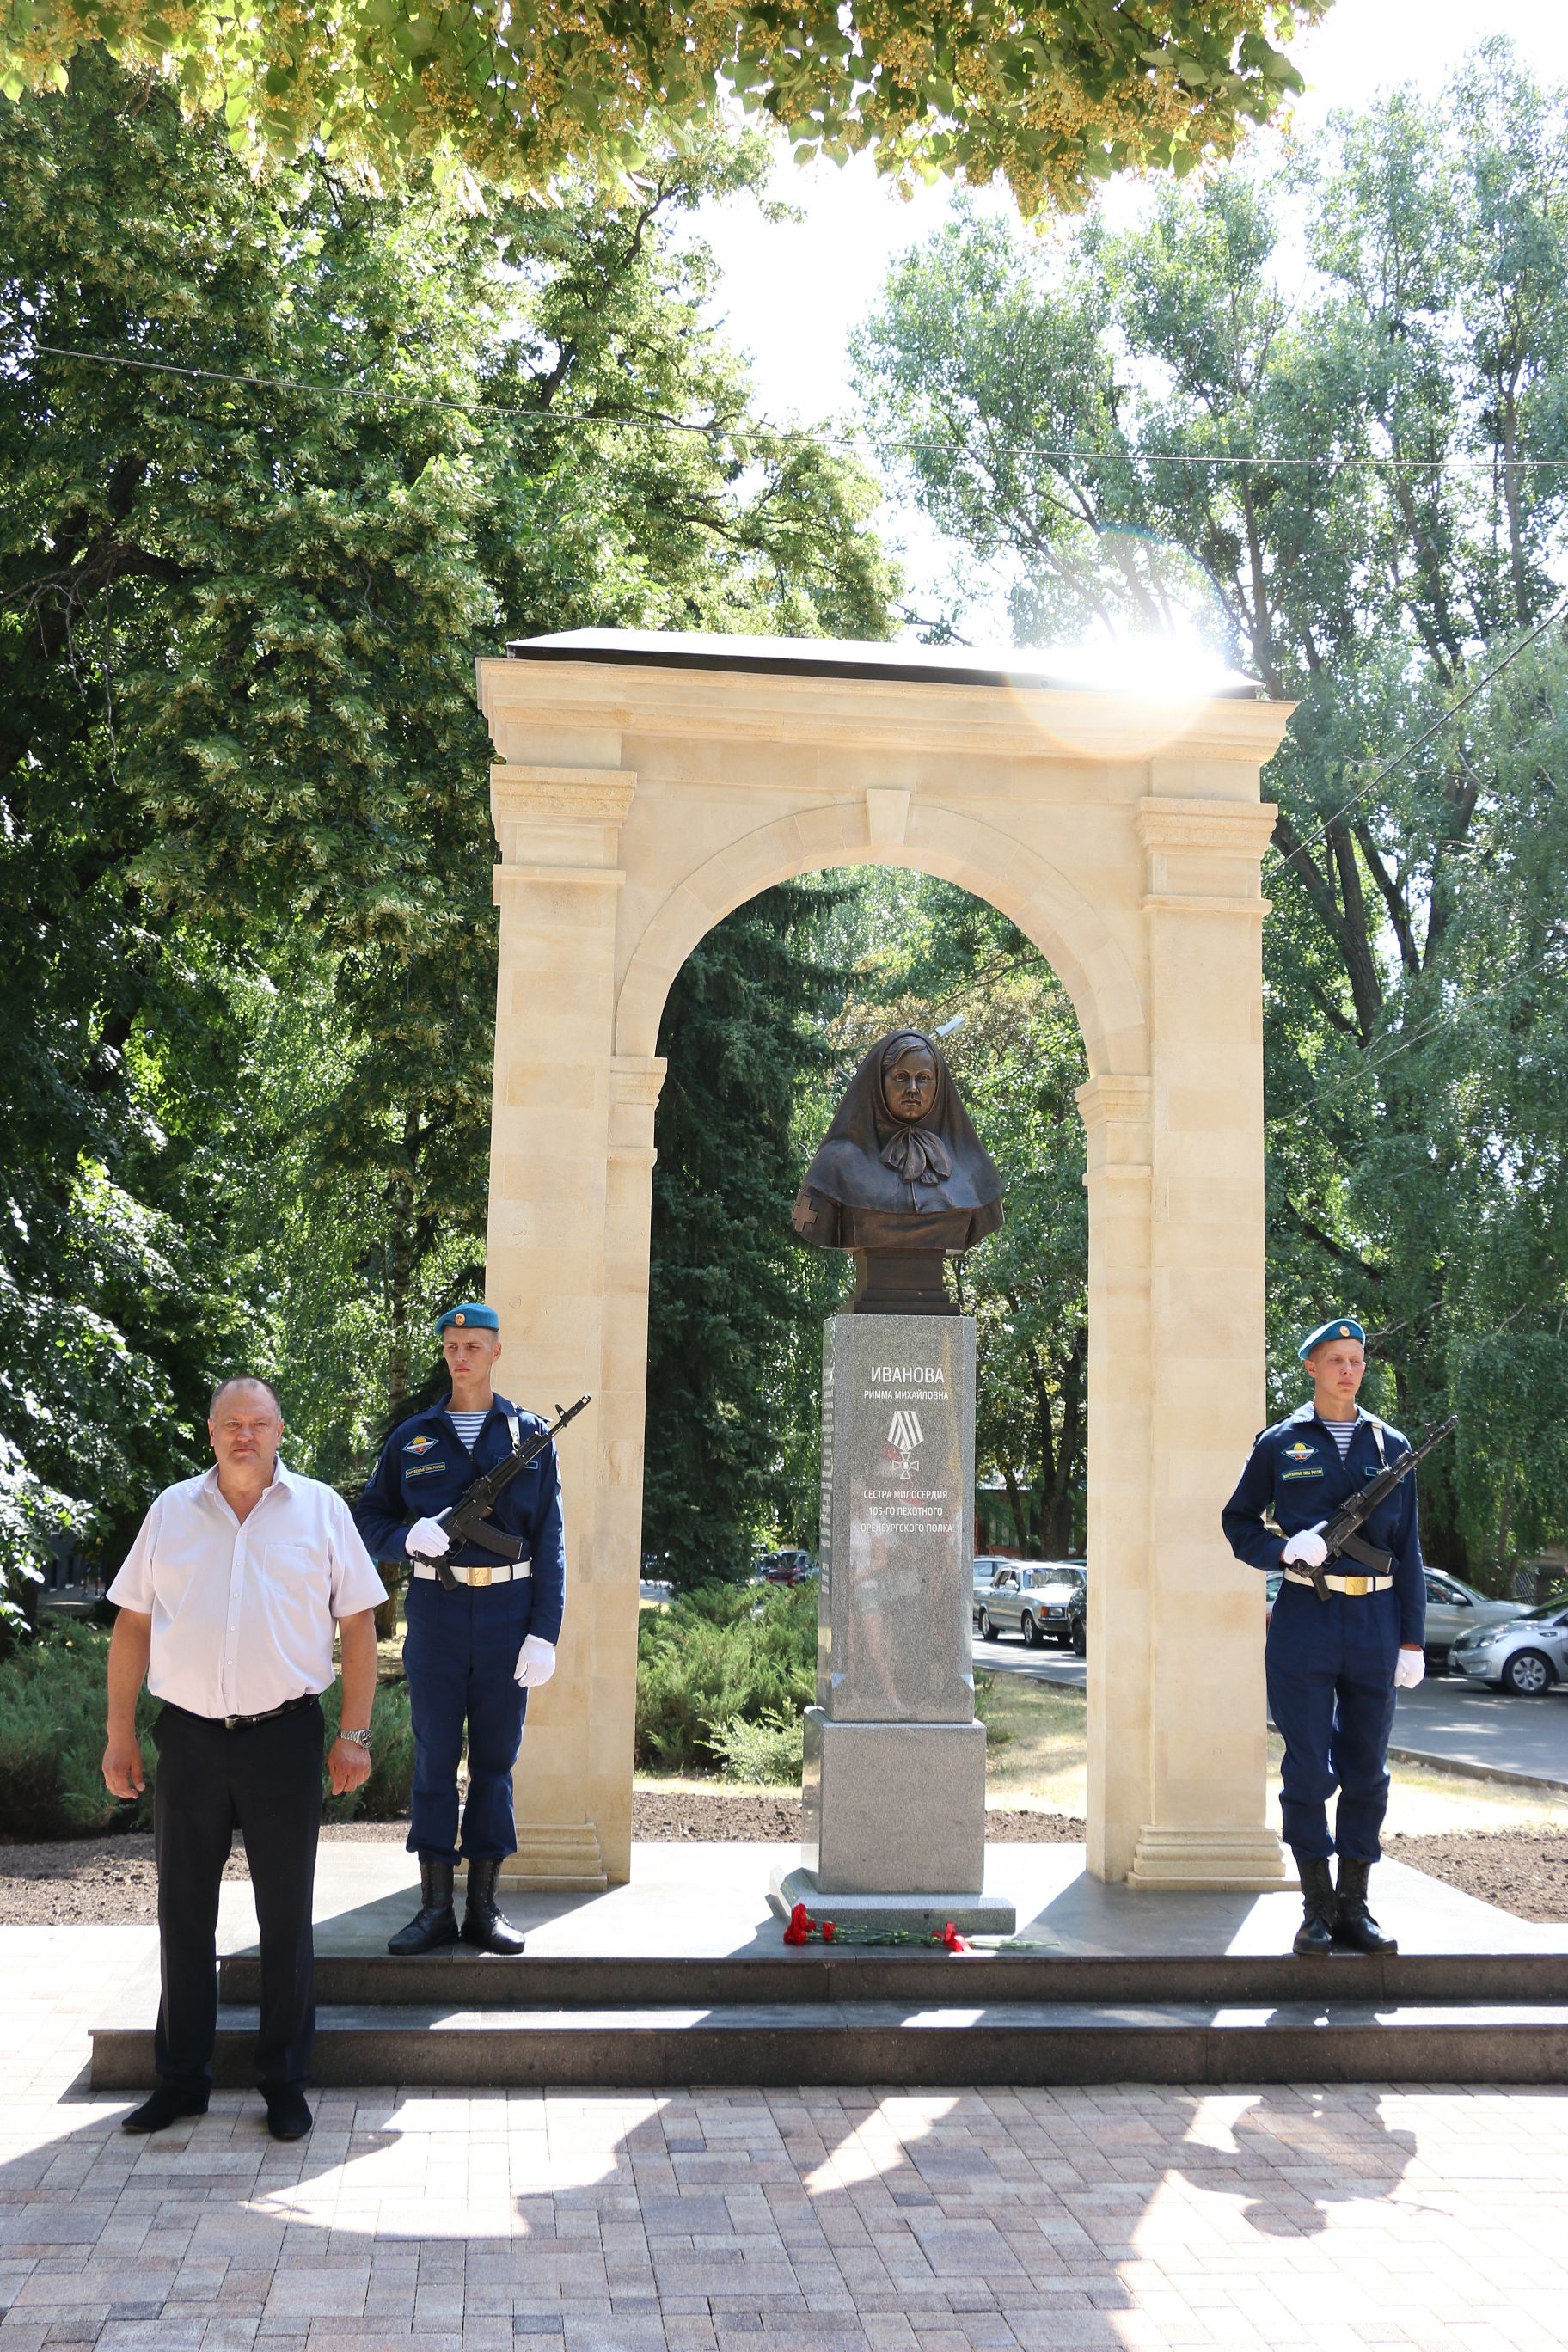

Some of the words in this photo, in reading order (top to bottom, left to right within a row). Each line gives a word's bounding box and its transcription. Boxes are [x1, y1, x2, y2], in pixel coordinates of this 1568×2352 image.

[871, 1366, 945, 1383] ИВАНОВА
[864, 1390, 893, 1400] РИММА
[895, 1388, 949, 1400] МИХАЙЛОВНА
[863, 1490, 892, 1499] СЕСТРА
[894, 1490, 948, 1500] МИЛОСЕРДИЯ
[869, 1506, 896, 1516] 105-ГО
[897, 1506, 943, 1516] ПЕХОТНОГО
[861, 1523, 925, 1533] ОРЕНБУРГСКОГО
[926, 1523, 953, 1533] ПОЛКА
